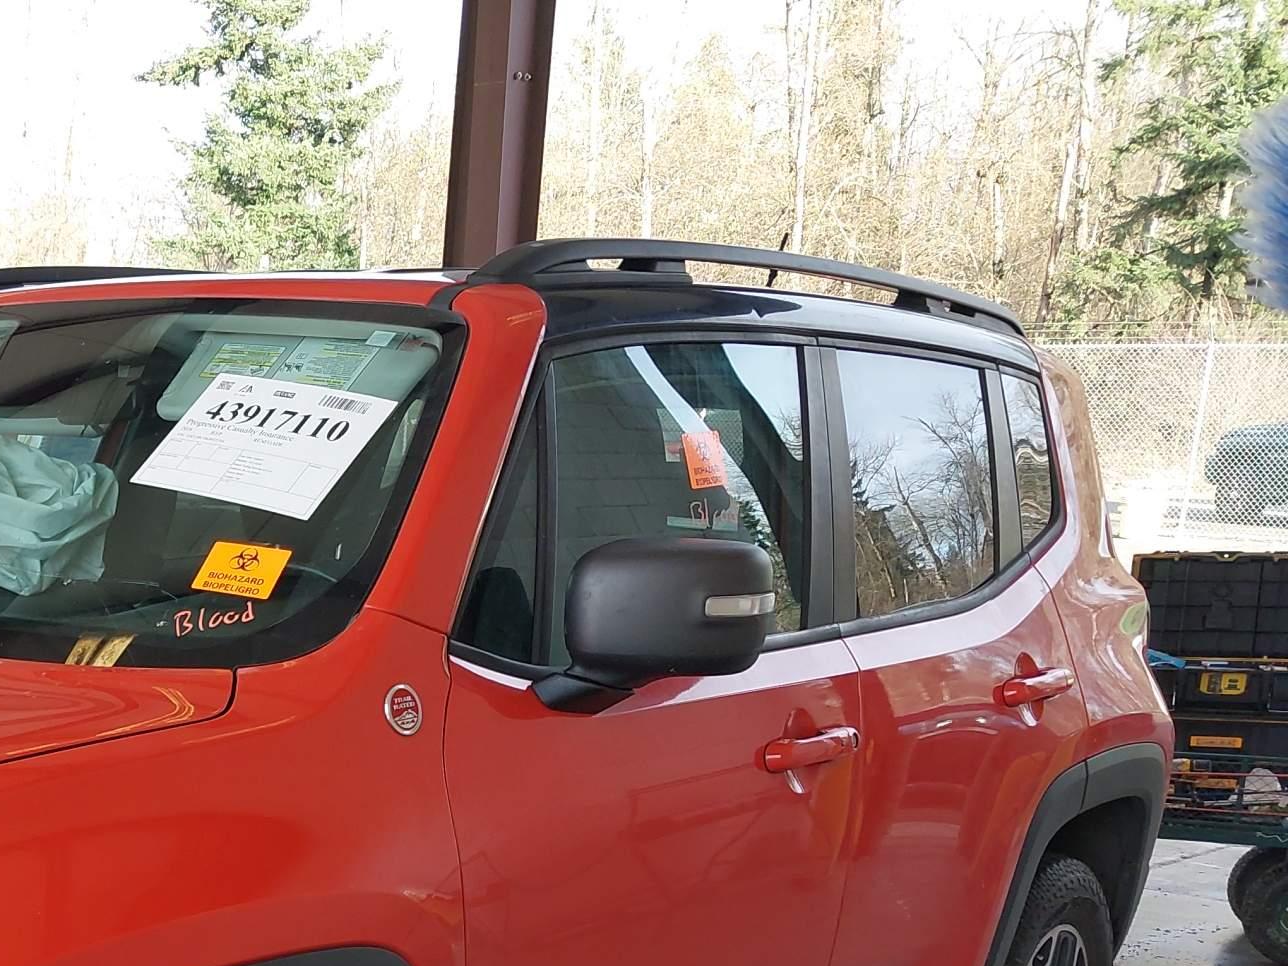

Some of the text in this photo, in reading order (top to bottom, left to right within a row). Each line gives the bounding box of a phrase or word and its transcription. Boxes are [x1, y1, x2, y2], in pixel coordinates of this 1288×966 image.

[206, 400, 350, 442] 43917110
[186, 418, 227, 432] Progressive
[227, 423, 259, 436] Casualty
[259, 429, 295, 442] Insurance
[208, 571, 265, 586] BIOHAZARD
[203, 580, 260, 595] BIOPELIGRO
[173, 601, 255, 637] Blood
[393, 696, 413, 704] TRAIL
[393, 702, 416, 711] RATED
